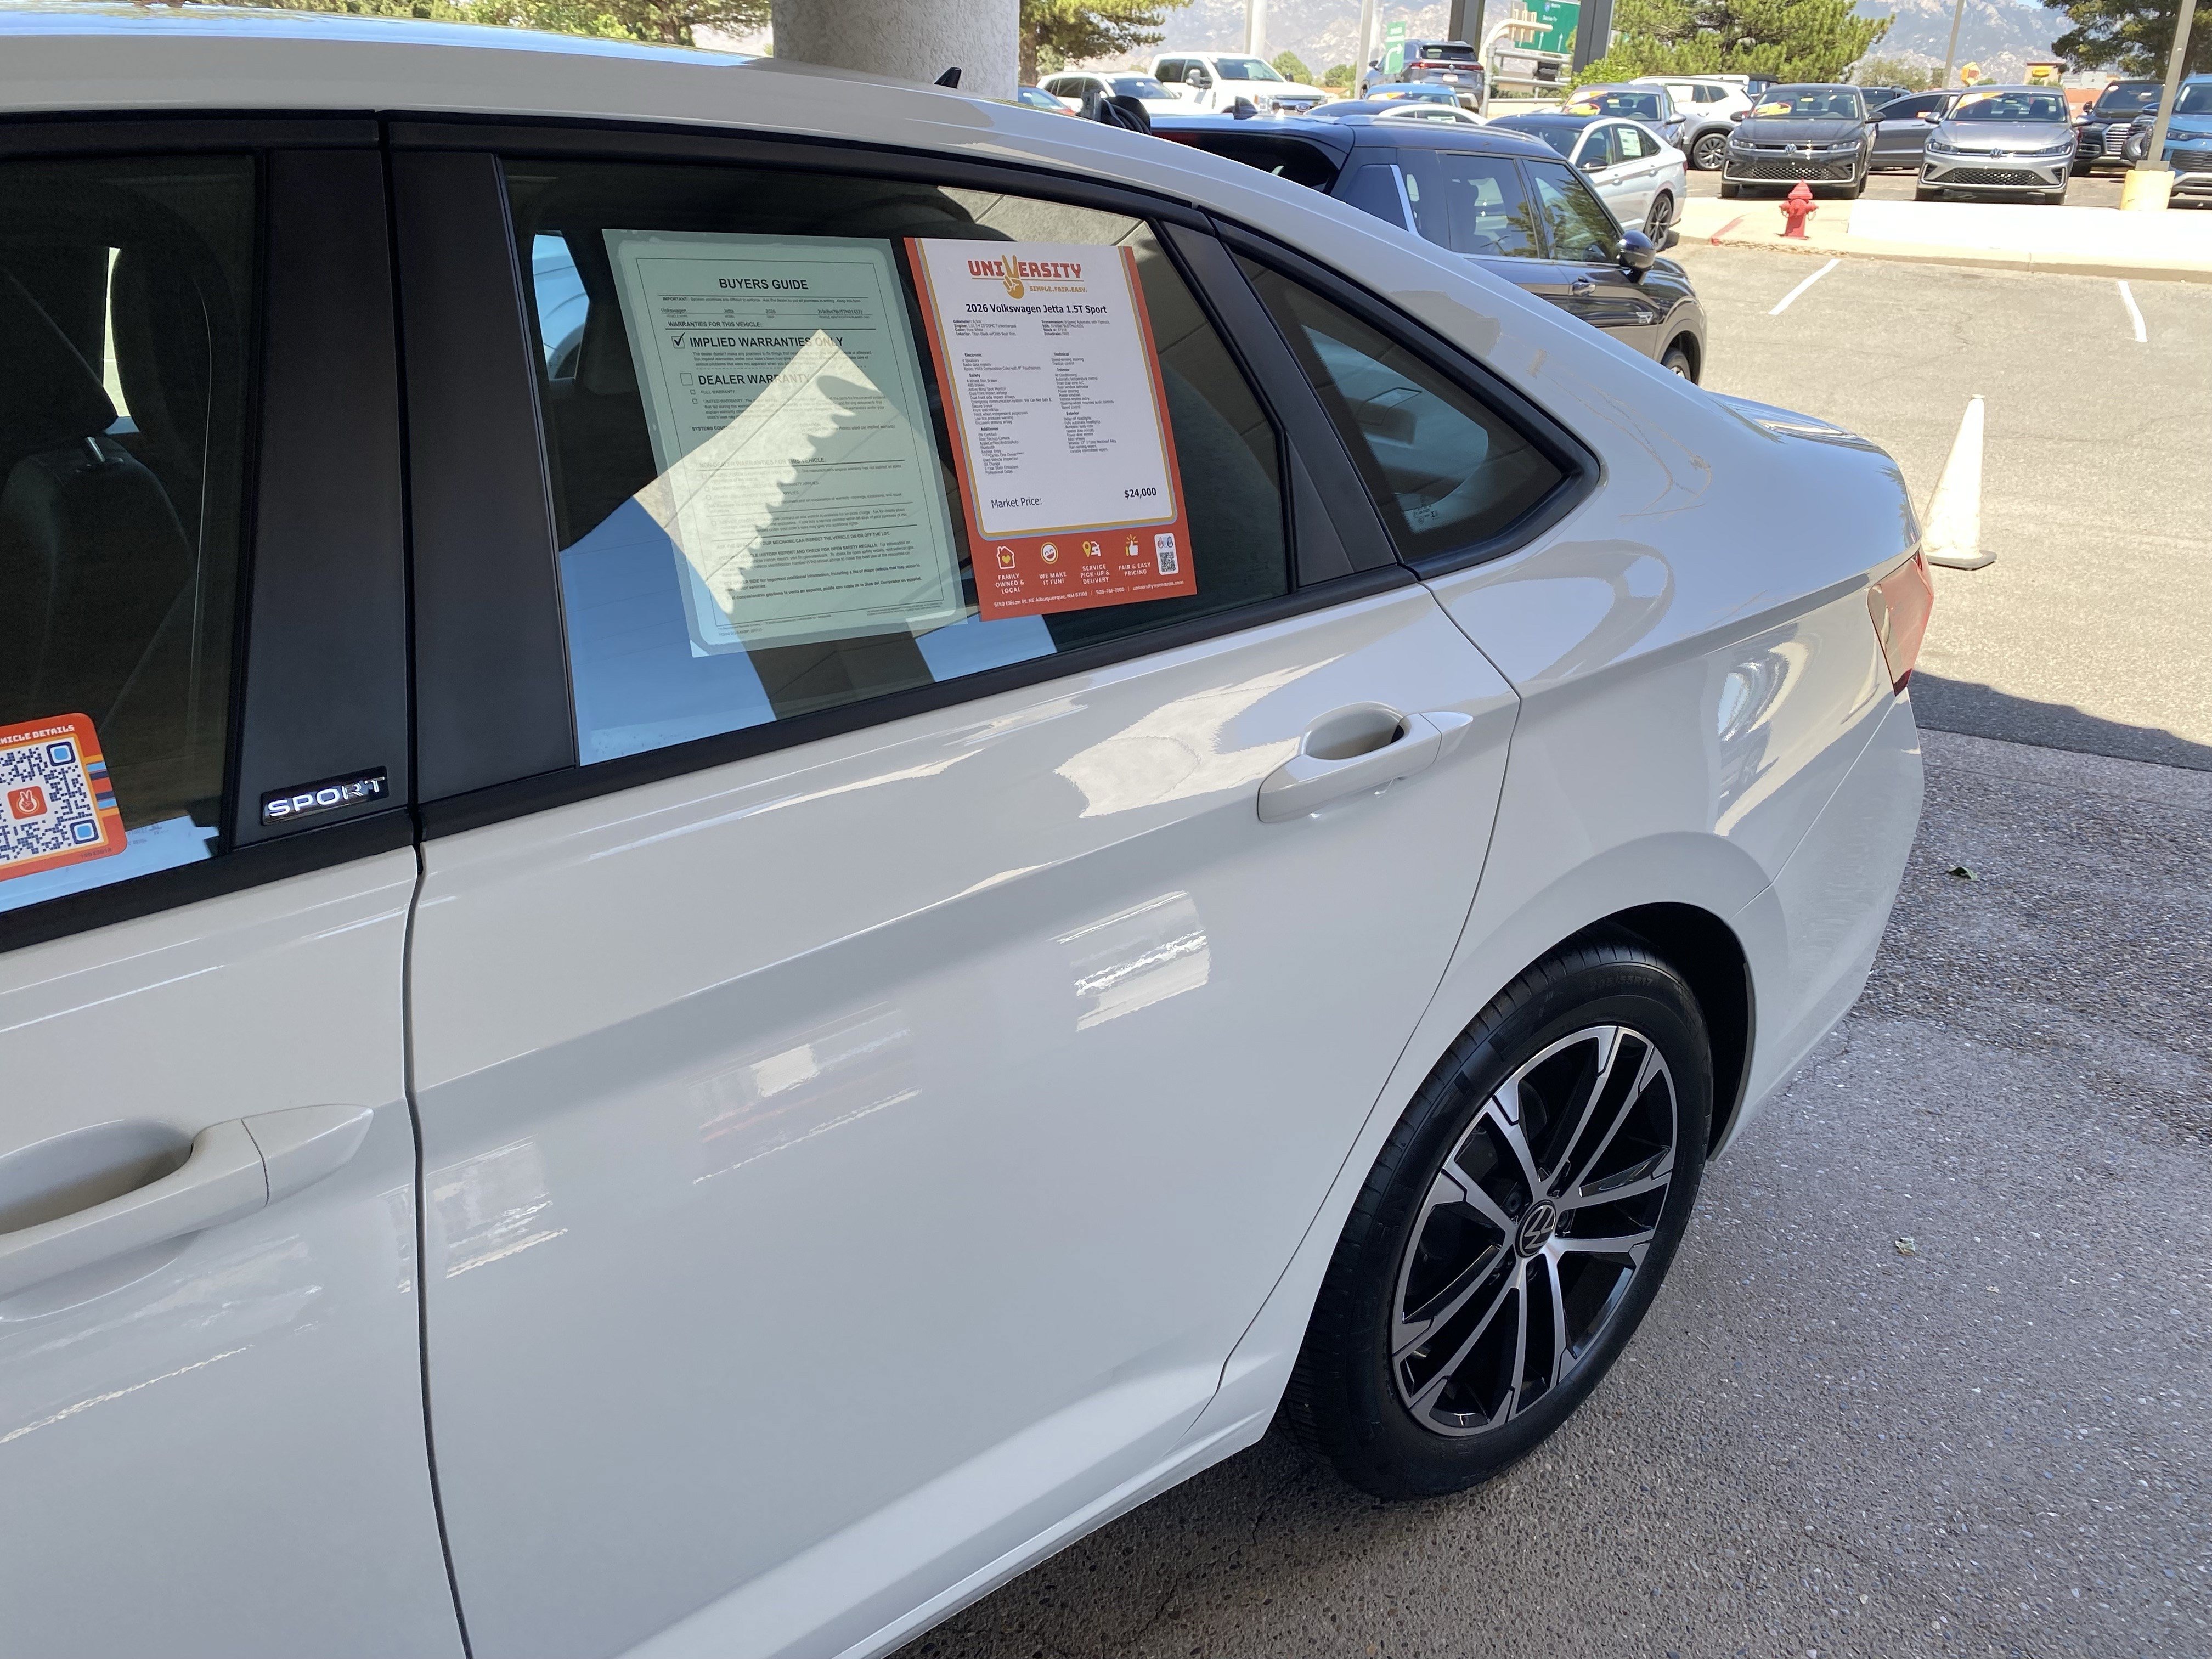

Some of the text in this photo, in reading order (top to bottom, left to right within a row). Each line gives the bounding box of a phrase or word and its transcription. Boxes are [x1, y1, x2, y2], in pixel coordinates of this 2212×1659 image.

[968, 255, 1081, 279] UNIVERSITY
[718, 278, 809, 289] BUYERS GUIDE
[965, 303, 1108, 315] 2026 Volkswagen Jetta 1.5T Sport
[689, 336, 844, 347] IMPLIED WARRANTIES ONLY
[697, 373, 810, 385] DEALER WARRANTY
[735, 459, 774, 467] WARRANTIES
[1124, 487, 1157, 499] $24,000
[990, 496, 1042, 509] Market Price:
[1080, 570, 1105, 578] PICK-UP
[995, 580, 1018, 588] OWNED
[1082, 576, 1109, 585] DELIVERY
[0, 725, 75, 745] HICLE DETAILS
[268, 777, 385, 817] SPORT
